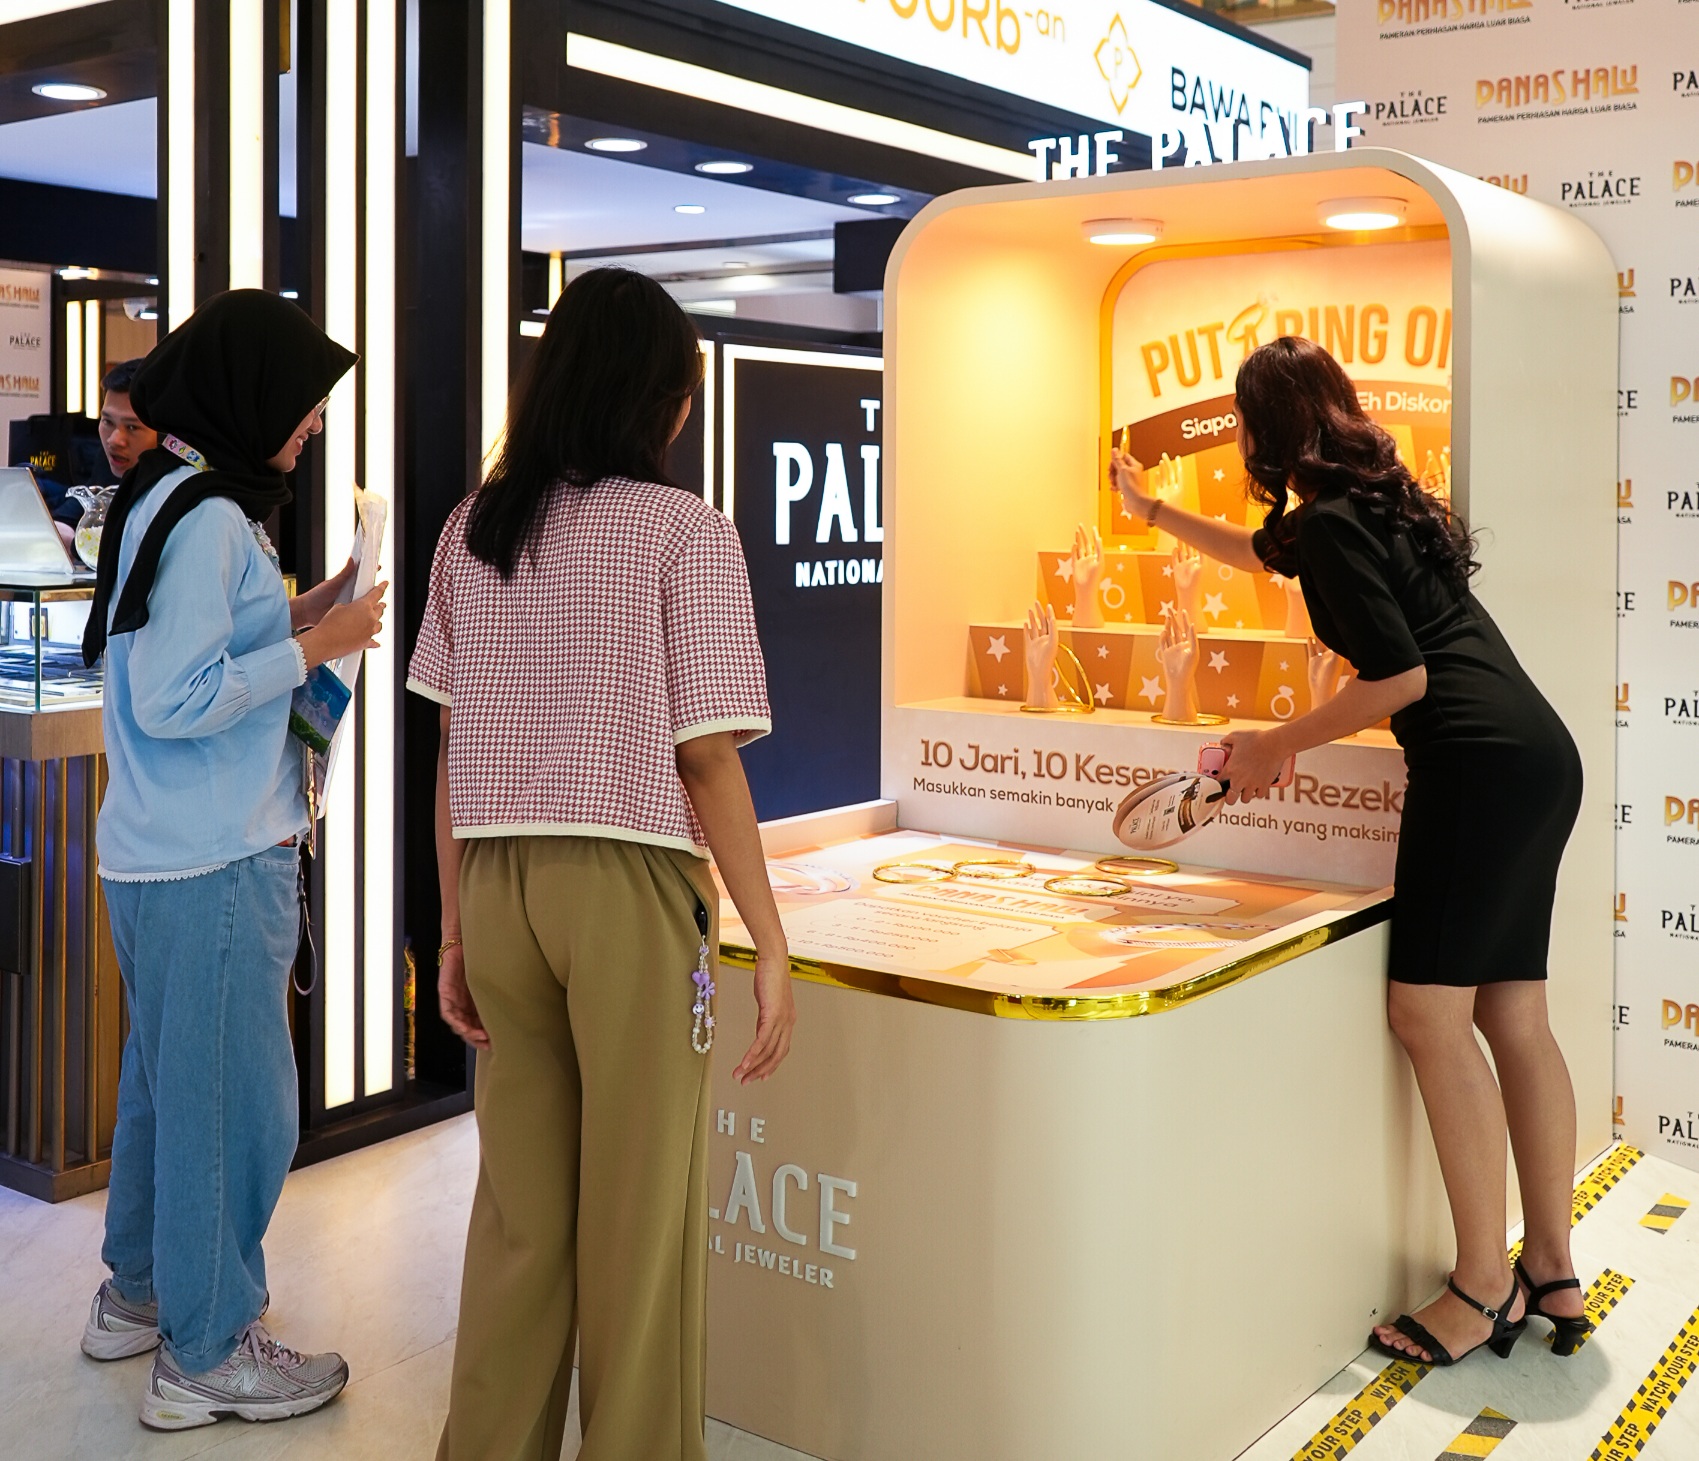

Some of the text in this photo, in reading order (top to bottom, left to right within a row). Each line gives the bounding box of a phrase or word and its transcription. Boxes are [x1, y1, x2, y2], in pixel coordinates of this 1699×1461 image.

[1572, 64, 1640, 100] HALU
[1375, 96, 1447, 120] PALACE
[1478, 102, 1637, 125] PAMERAN PERHIASAN HARGA LUAR BIASA
[1028, 130, 1124, 183] THE
[1561, 177, 1640, 201] PALACE
[9, 334, 41, 348] PALACE
[1140, 321, 1224, 398] PUT
[1181, 413, 1238, 439] Siapa
[920, 738, 953, 768] 10
[959, 742, 1026, 780] Jari,
[1033, 749, 1068, 780] 10
[1294, 772, 1408, 813] Rezek
[913, 777, 986, 798] Masukkan
[989, 787, 1052, 806] semakin
[1056, 792, 1114, 814] banyak
[1218, 812, 1278, 830] hadiah
[1283, 819, 1327, 841] yang
[1664, 1038, 1699, 1051] PAMERA
[717, 1109, 766, 1143] HE
[709, 1150, 857, 1261] ACE
[734, 1242, 834, 1289] JEWELER
[1584, 1273, 1625, 1314] YOUR STEP
[1370, 1366, 1410, 1400] WATCH
[1640, 1334, 1699, 1413] WATCH YOUR STEP
[1333, 1409, 1363, 1436] STEP
[1620, 1422, 1640, 1450] STEP
